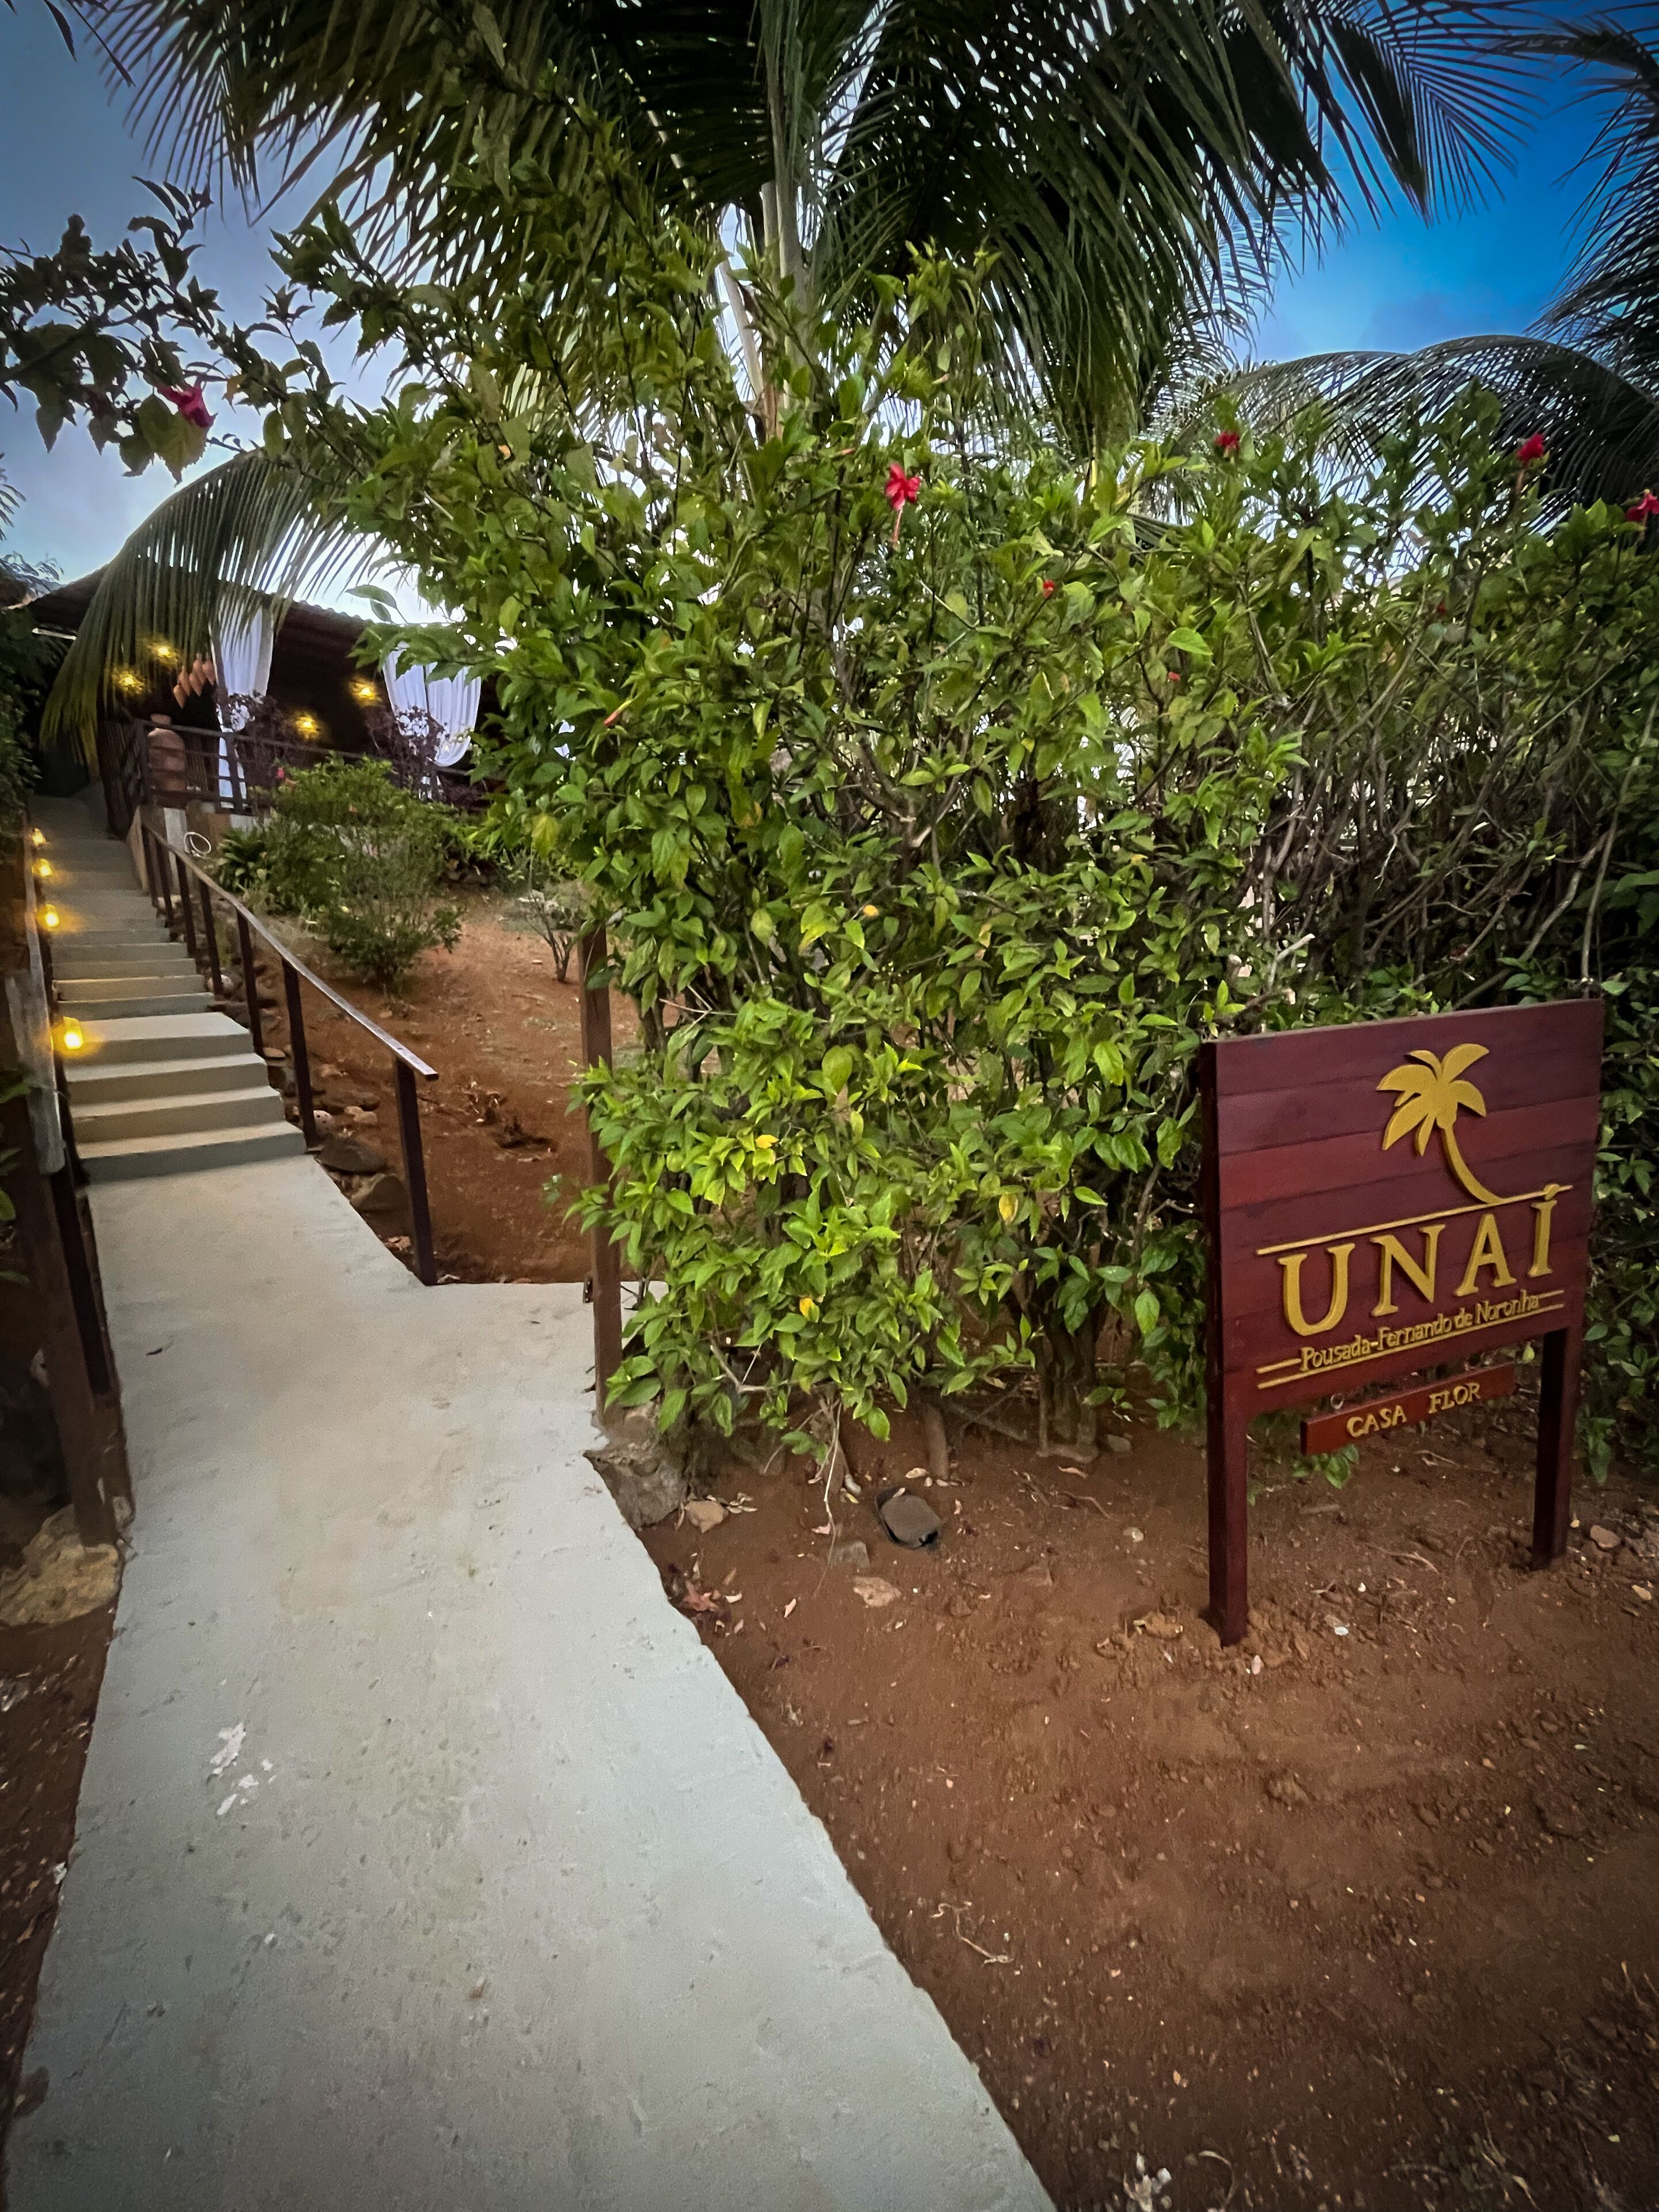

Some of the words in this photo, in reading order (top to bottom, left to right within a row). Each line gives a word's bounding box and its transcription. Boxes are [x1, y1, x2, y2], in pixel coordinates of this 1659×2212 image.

[1453, 1307, 1474, 1329] de
[1475, 1289, 1540, 1324] Noronha
[1346, 1404, 1407, 1438] CASA
[1428, 1382, 1481, 1414] FLOR
